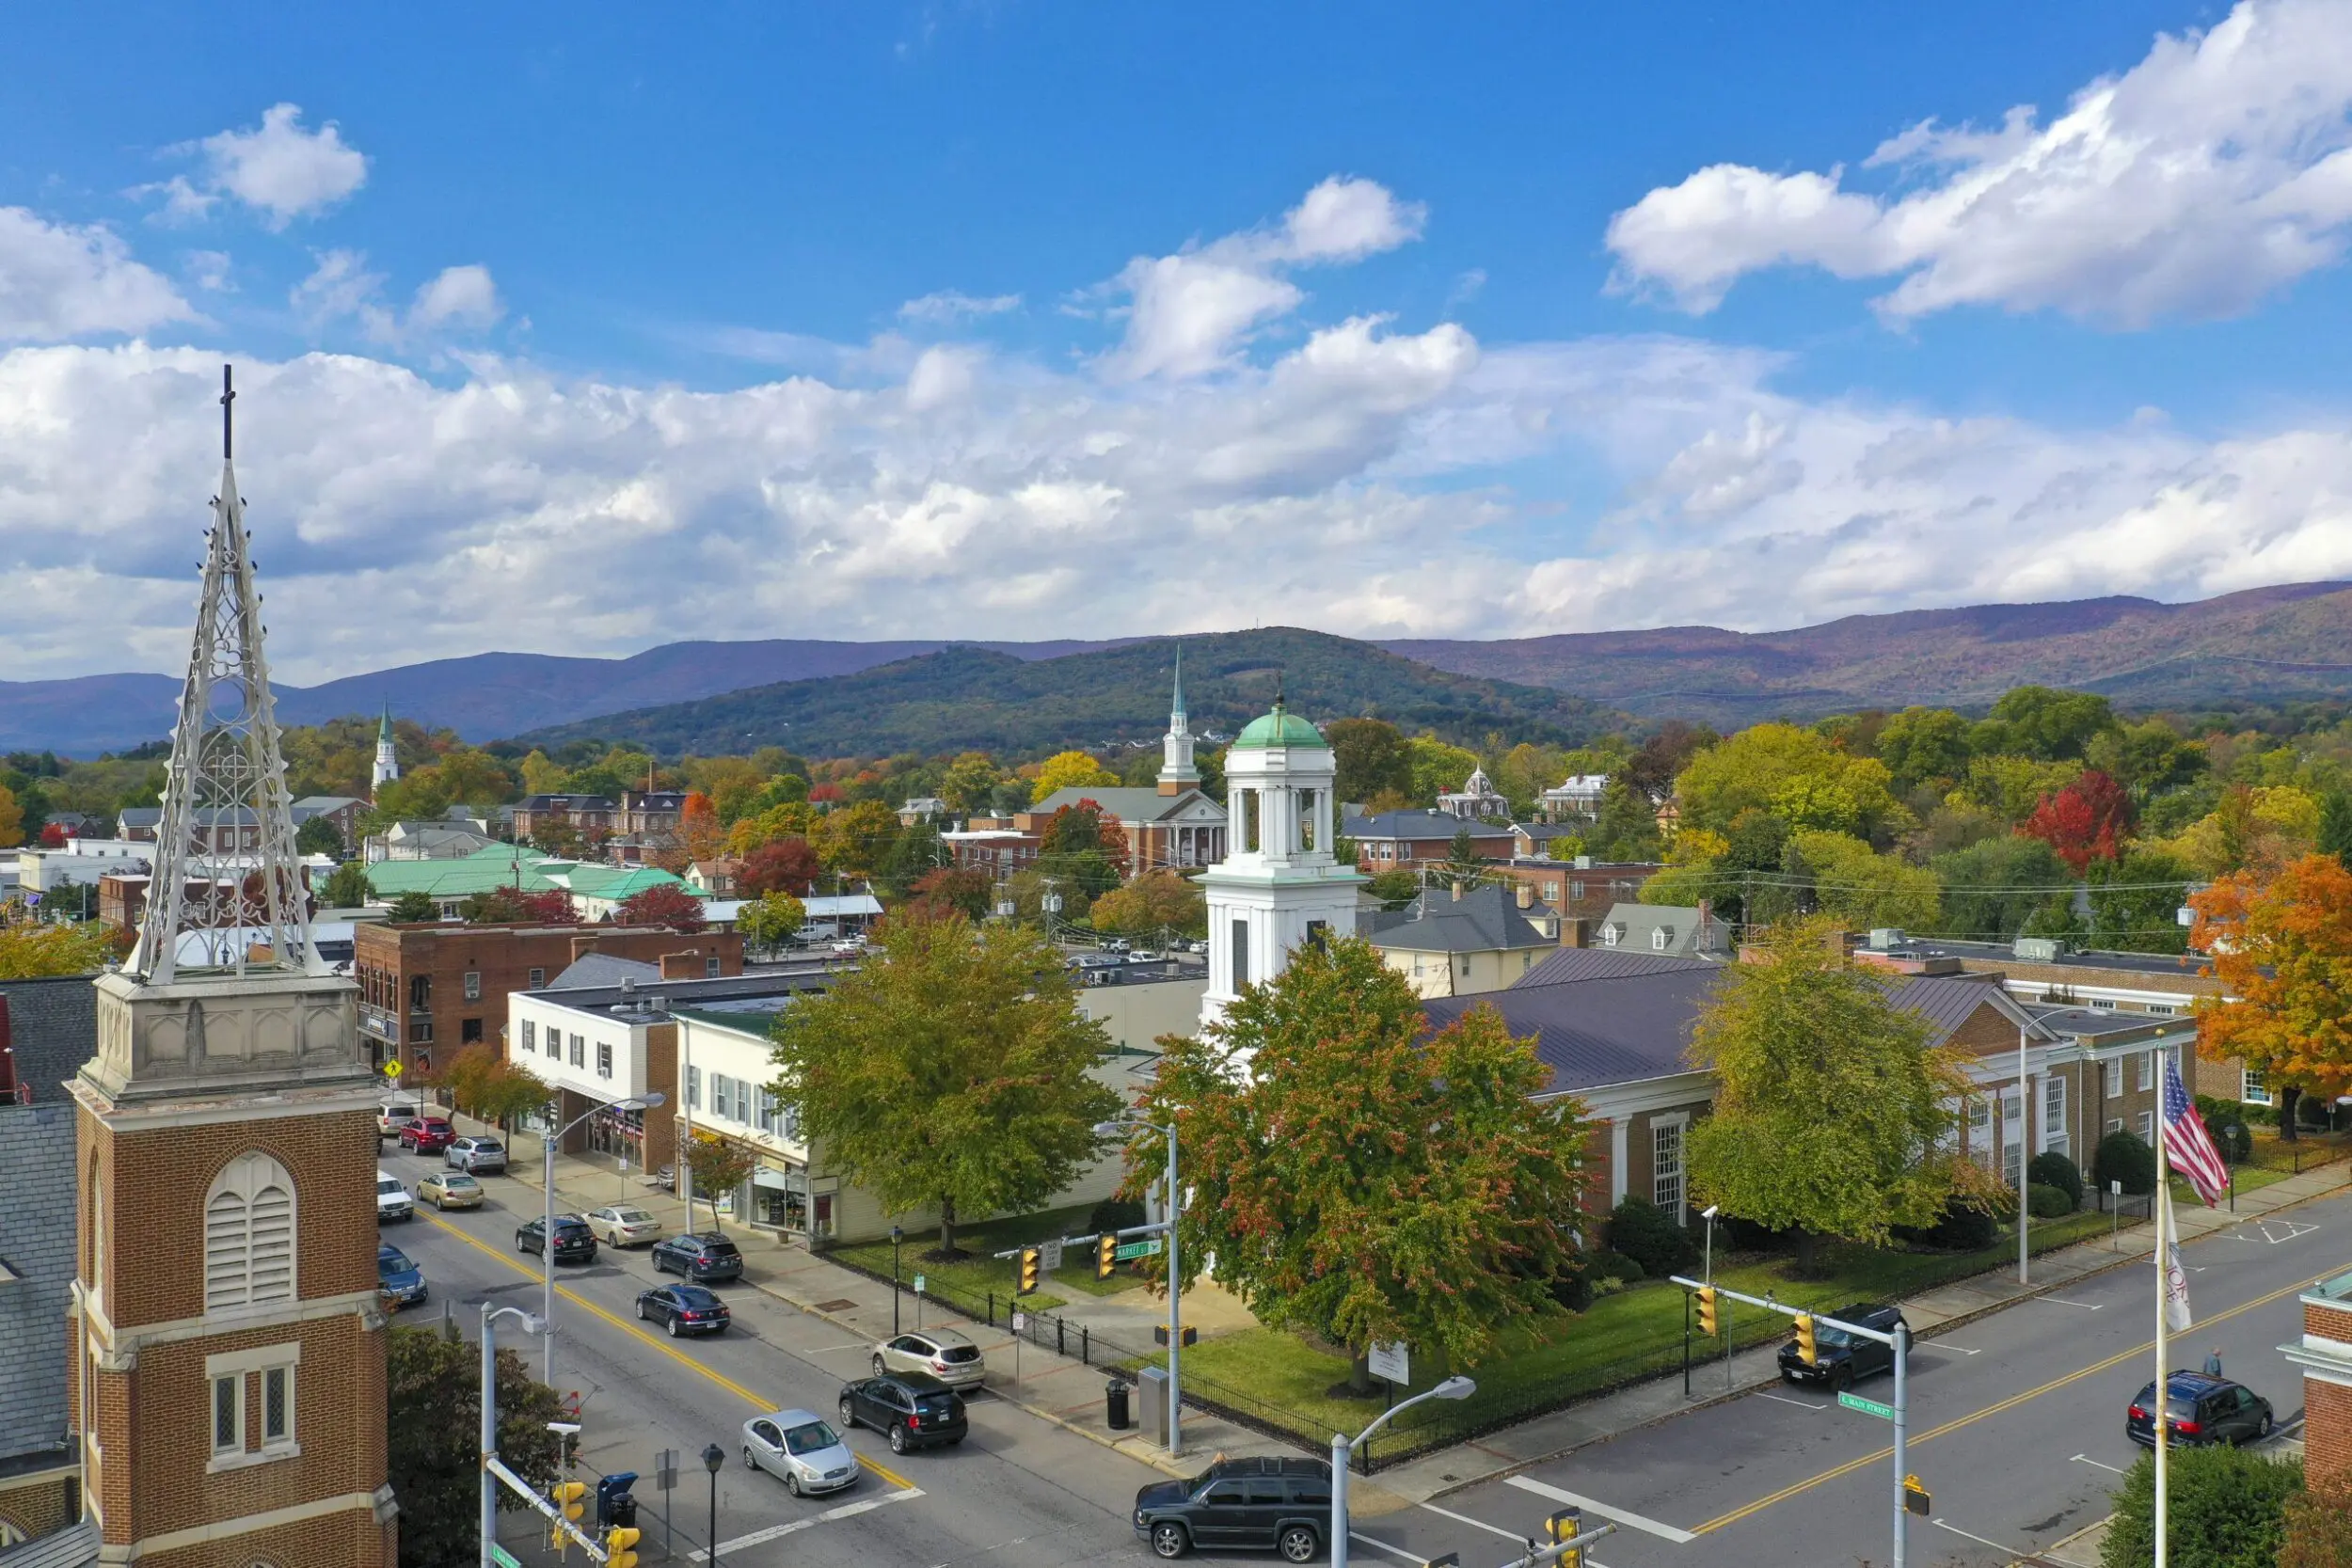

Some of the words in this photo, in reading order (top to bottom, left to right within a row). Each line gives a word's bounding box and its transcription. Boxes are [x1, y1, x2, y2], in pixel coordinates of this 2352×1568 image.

[1117, 1243, 1139, 1257] MARKET
[1849, 1398, 1865, 1409] MAIN
[1866, 1402, 1891, 1417] STREET
